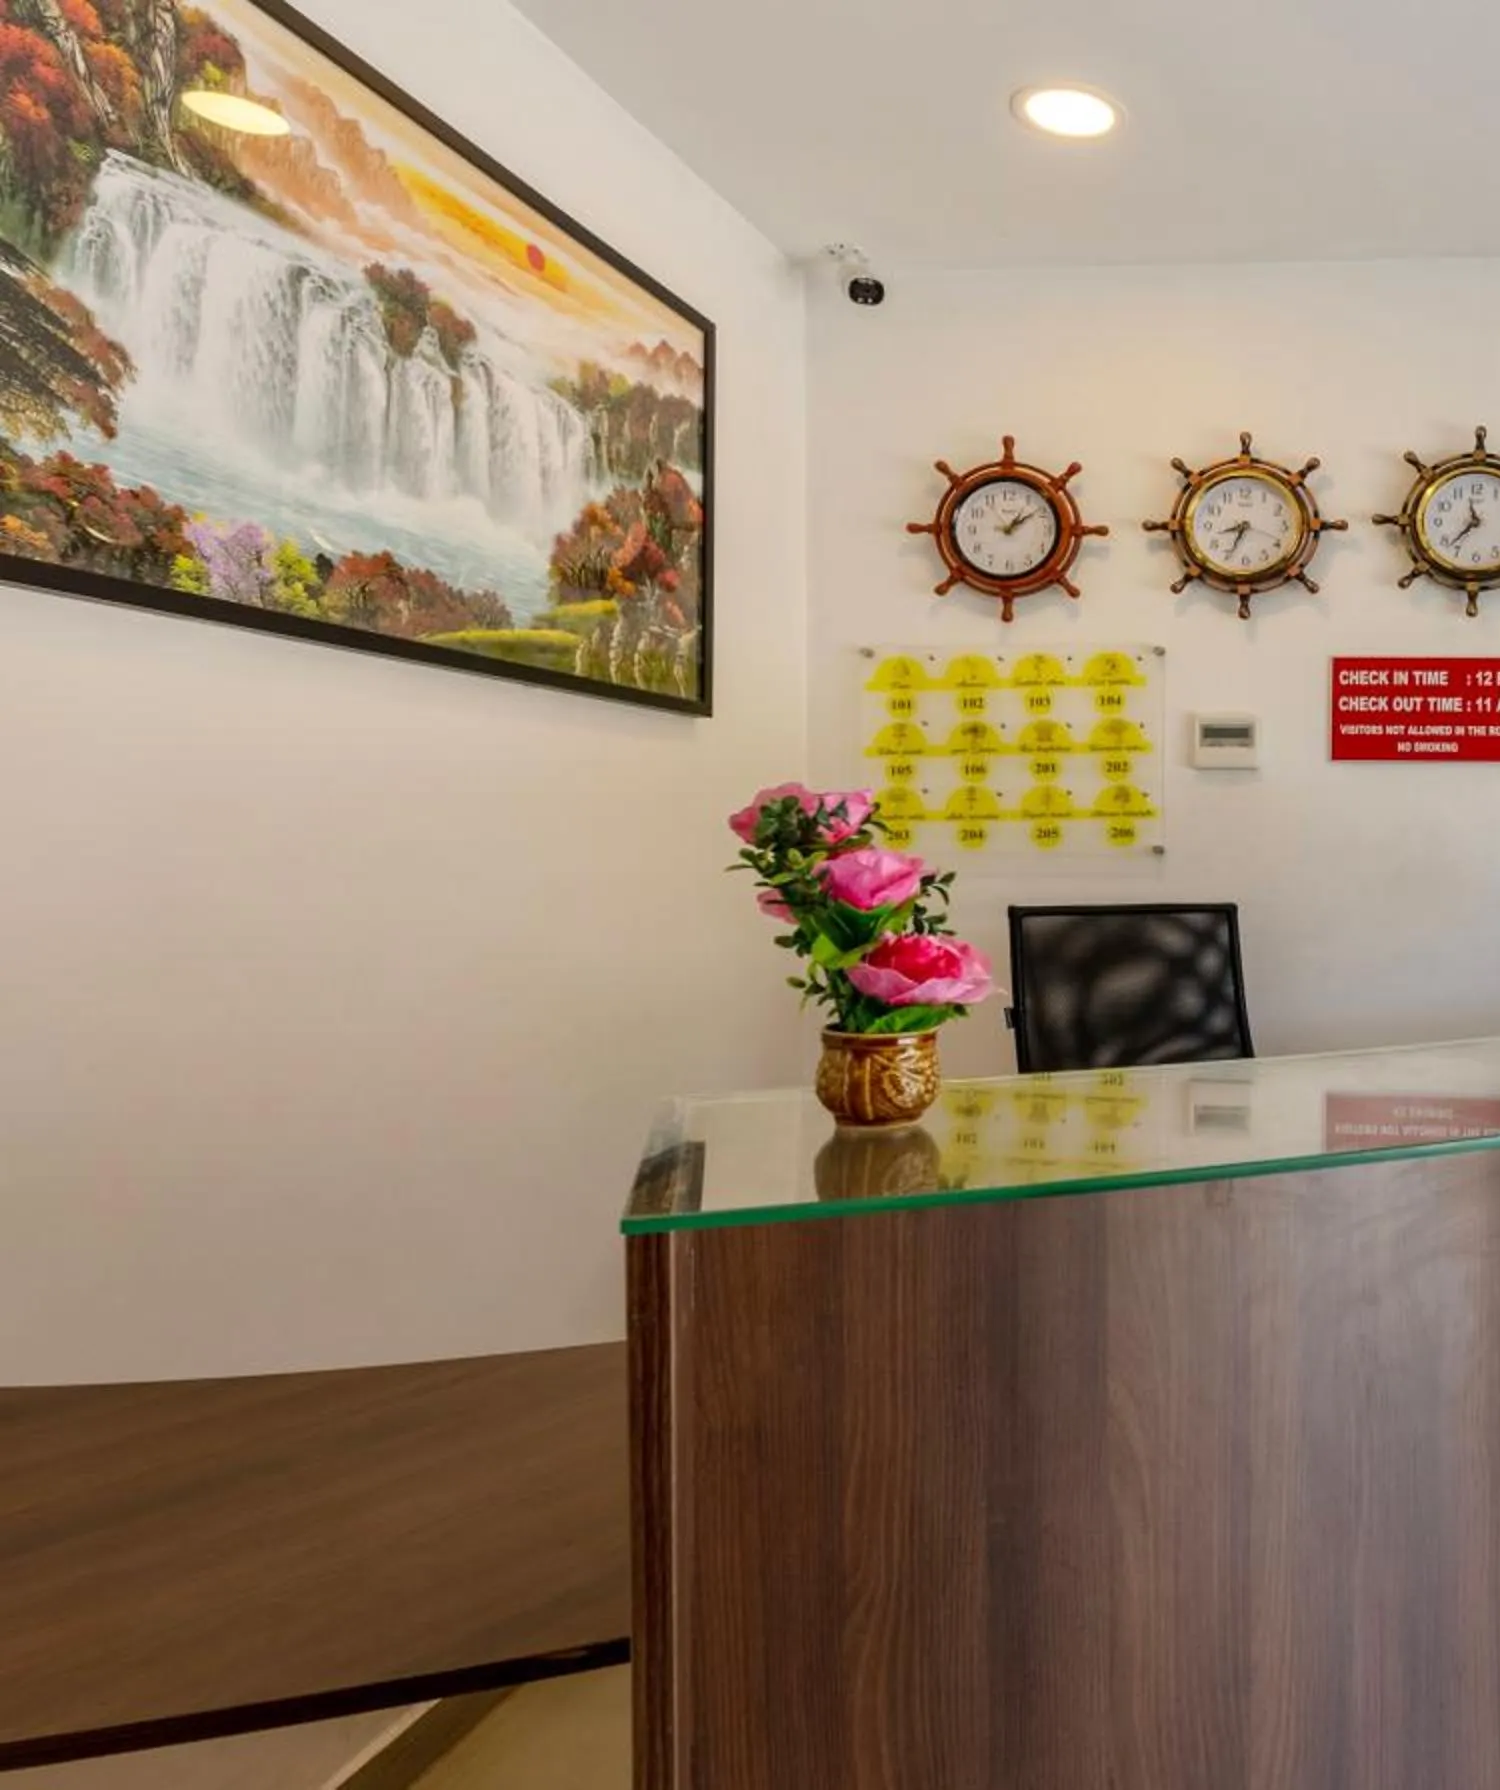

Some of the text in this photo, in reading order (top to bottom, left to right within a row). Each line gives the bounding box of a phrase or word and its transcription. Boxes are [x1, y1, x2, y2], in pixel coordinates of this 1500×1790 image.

[1239, 488, 1251, 498] 12
[1454, 487, 1462, 500] 11
[1471, 484, 1483, 494] 12
[1494, 488, 1497, 499] 1
[1002, 488, 1016, 501] 12
[1223, 493, 1232, 503] 11
[1262, 492, 1266, 503] 1
[986, 495, 994, 505] 11
[1026, 495, 1030, 505] 1
[1208, 505, 1221, 516] 10
[1274, 505, 1282, 516] 2
[1438, 501, 1451, 512] 10
[972, 509, 983, 518] 10
[1204, 521, 1212, 531] 9
[1282, 521, 1288, 531] 3
[1434, 518, 1442, 527] 9
[968, 525, 976, 535] 9
[1210, 540, 1219, 549] 8
[1273, 539, 1280, 548] 4
[1440, 536, 1449, 545] 8
[1260, 550, 1269, 561] 5
[1454, 546, 1460, 557] 7
[1492, 546, 1499, 557] 5
[1242, 556, 1250, 565] 6
[1472, 552, 1480, 562] 6
[1339, 671, 1388, 685] CHECK
[1394, 671, 1408, 685] IN
[1413, 672, 1448, 685] TIME
[1476, 671, 1492, 685] 12
[892, 700, 911, 710] 101
[962, 698, 984, 709] 102
[1030, 698, 1051, 707] 103
[1100, 696, 1121, 706] 104
[1339, 697, 1388, 711] CHECK
[1393, 697, 1423, 711] OUT
[1427, 698, 1462, 712] TIME
[1476, 698, 1491, 712] 11
[1340, 725, 1382, 735] VISITORS
[1386, 725, 1405, 735] NOT
[1408, 725, 1452, 735] ALLOWED
[1455, 726, 1464, 735] IN
[1468, 726, 1486, 736] THE
[1398, 742, 1458, 752] NO SMOKING
[890, 766, 912, 776] 105
[964, 765, 986, 775] 106
[1035, 763, 1056, 772] 201
[1106, 762, 1128, 772] 202
[888, 830, 909, 840] 203
[961, 830, 984, 840] 204
[1036, 828, 1059, 838] 205
[1111, 828, 1134, 838] 206
